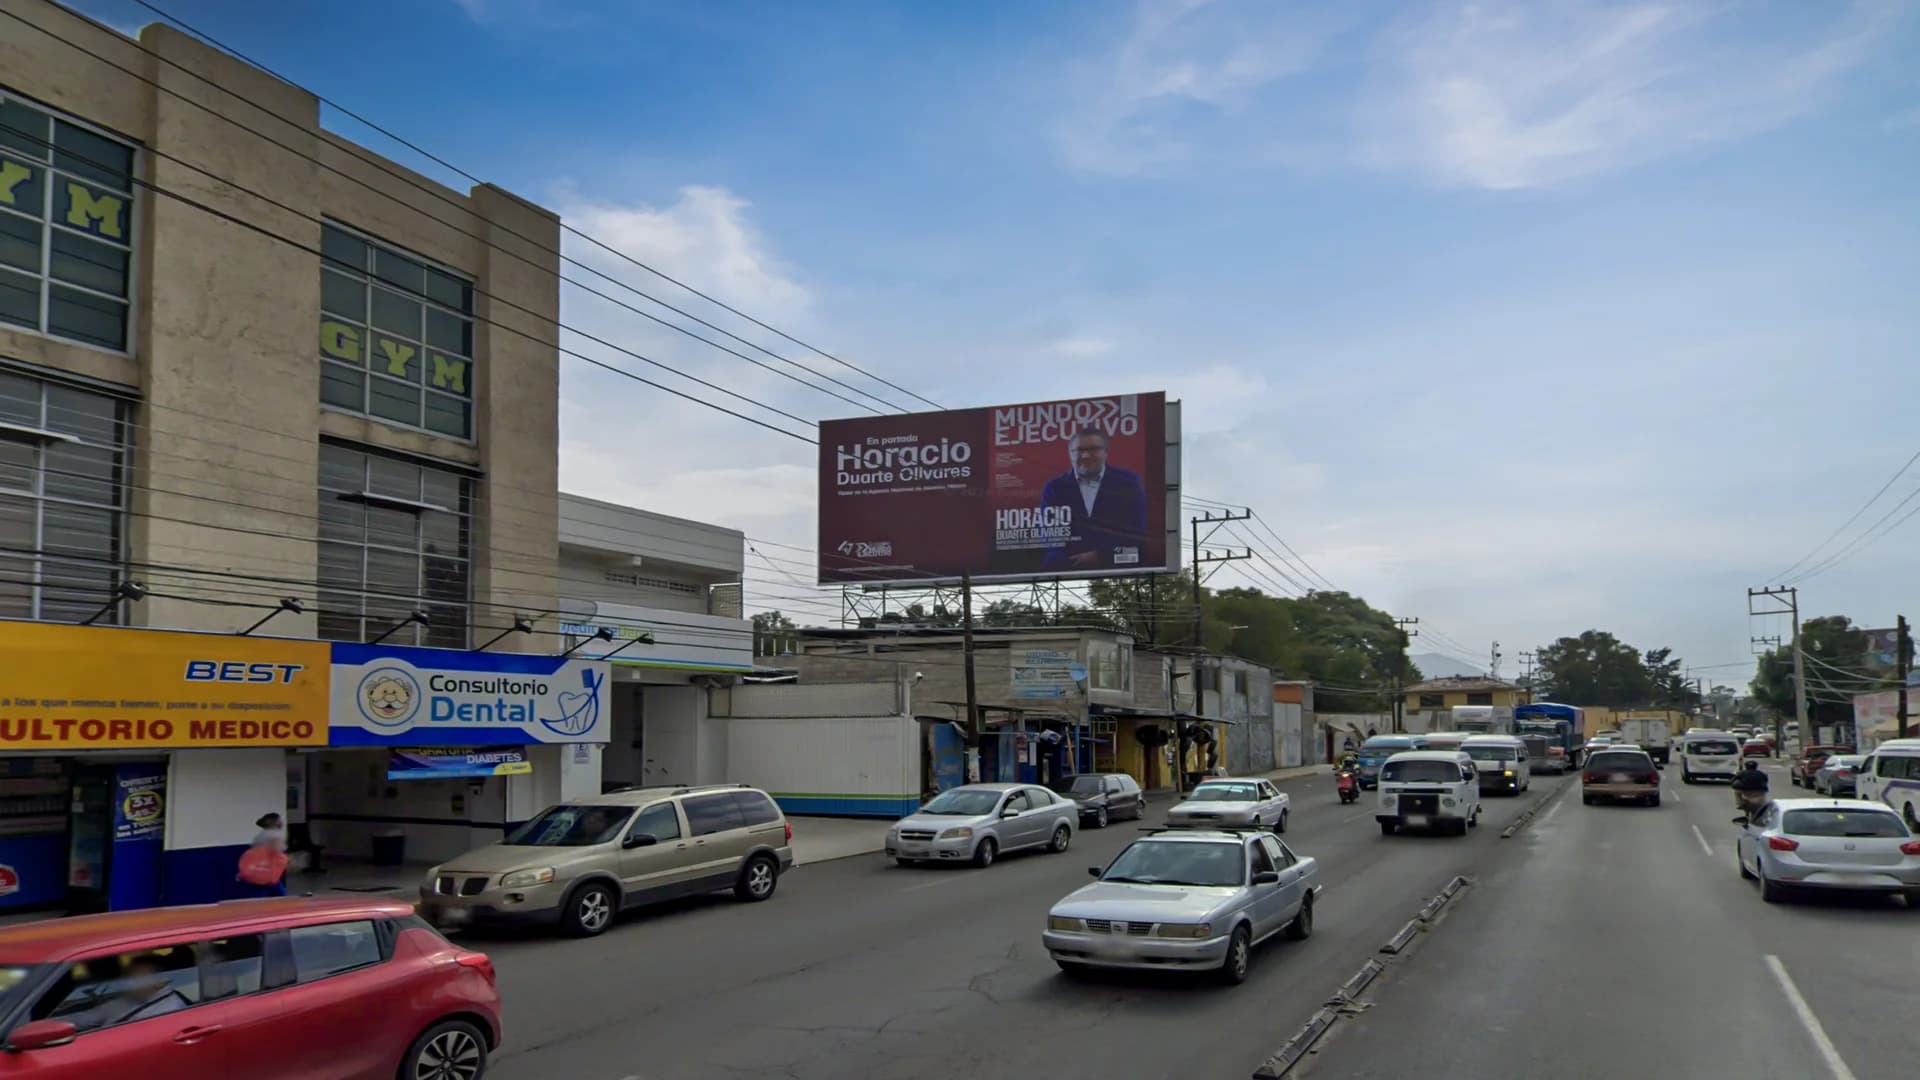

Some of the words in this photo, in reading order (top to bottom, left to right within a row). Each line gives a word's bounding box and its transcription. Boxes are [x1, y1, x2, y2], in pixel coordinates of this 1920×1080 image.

[320, 320, 466, 393] GYM
[995, 401, 1092, 427] MUNDO
[866, 436, 880, 446] En
[881, 434, 918, 446] portada
[837, 437, 972, 471] Horacio
[837, 471, 894, 485] Duarte
[996, 505, 1072, 530] HORACIO
[996, 528, 1029, 540] DUARTE
[184, 660, 304, 684] BEST
[429, 674, 549, 696] Consultorio
[431, 696, 535, 722] Dental
[0, 718, 174, 742] ULTORIO
[189, 719, 315, 740] MEDICO
[466, 752, 523, 765] DIABETES
